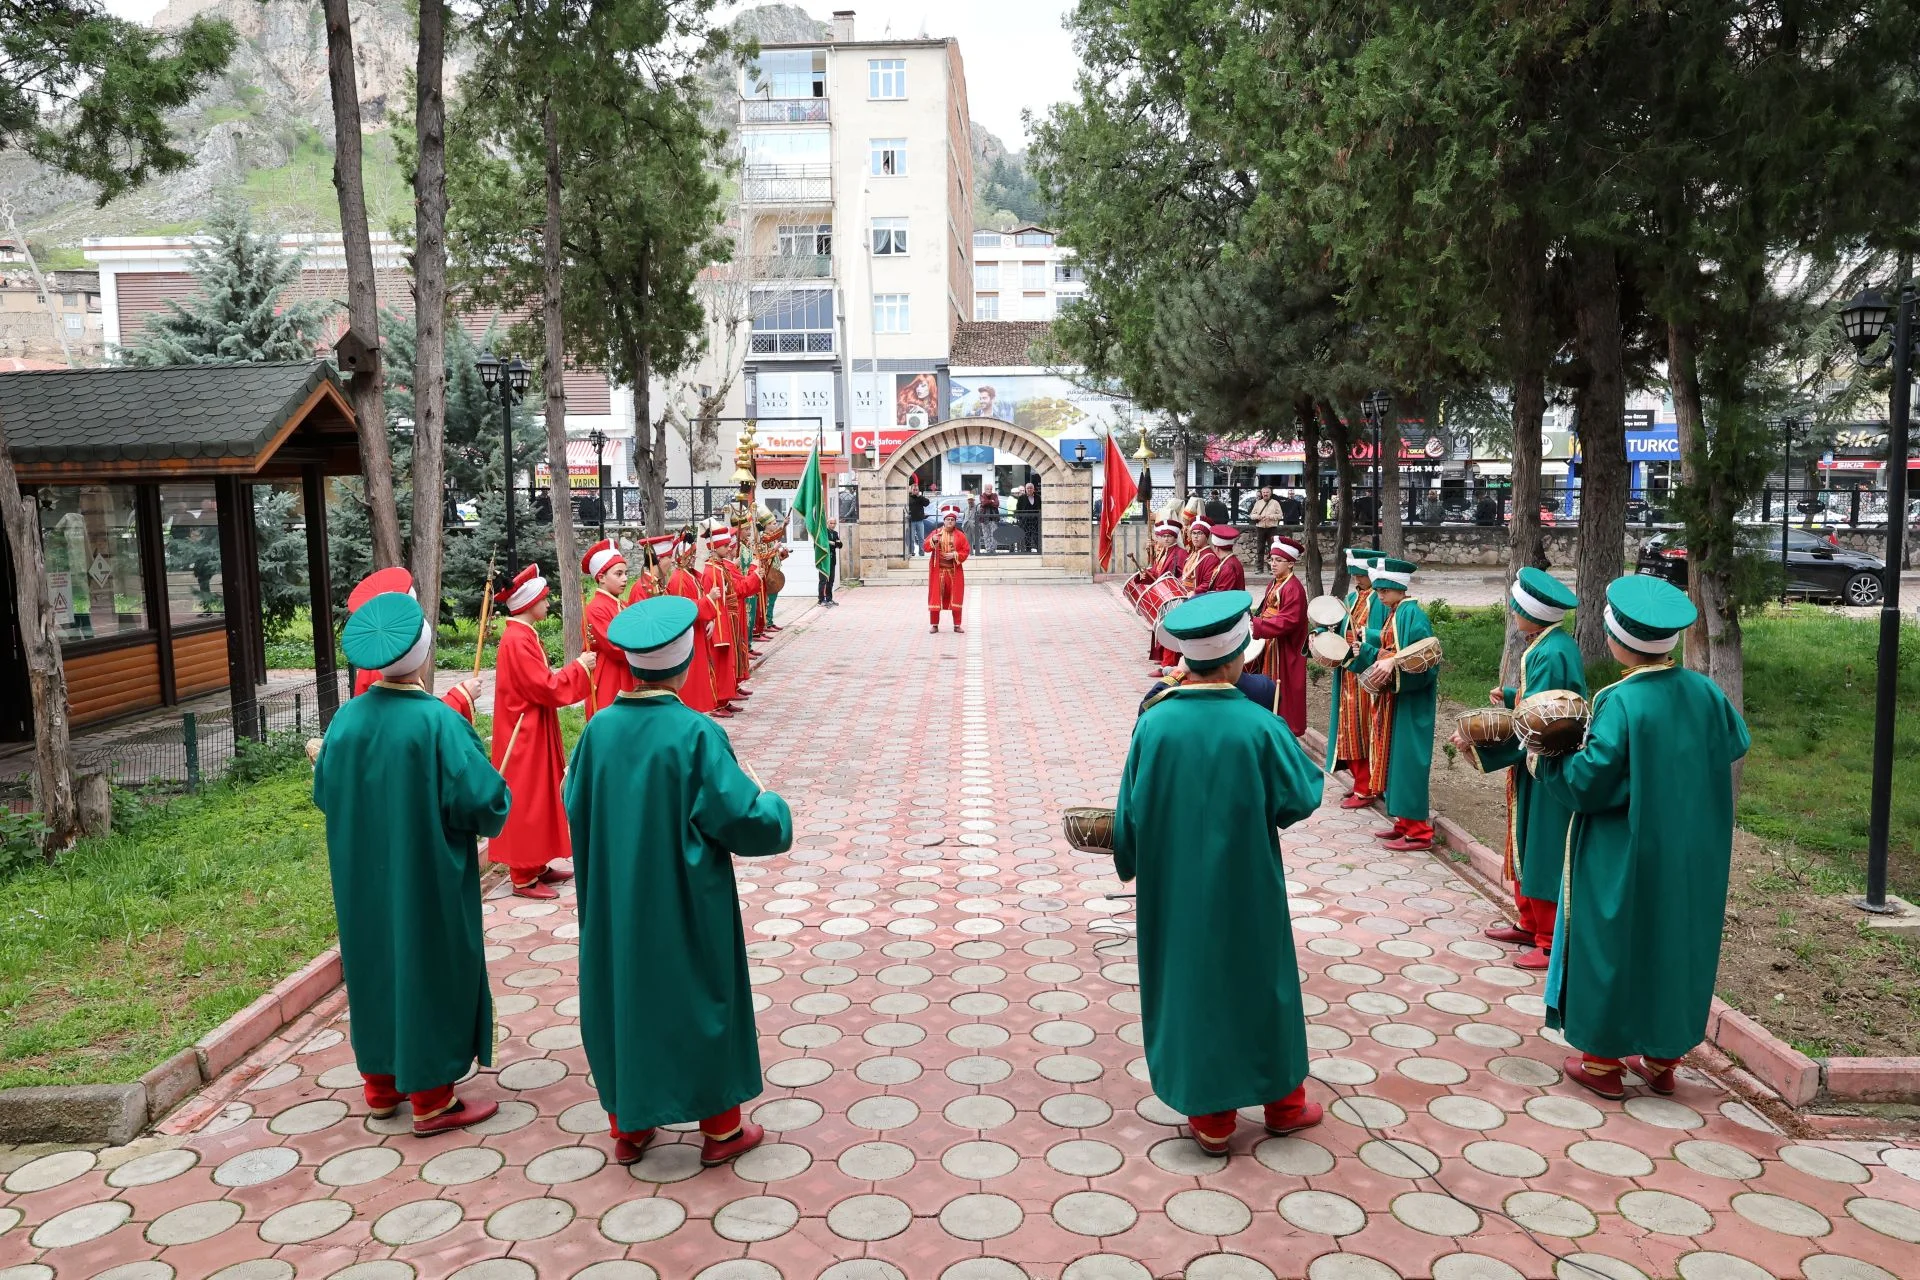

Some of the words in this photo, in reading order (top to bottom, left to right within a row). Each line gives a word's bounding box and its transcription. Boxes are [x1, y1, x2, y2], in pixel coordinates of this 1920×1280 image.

[762, 391, 788, 408] MS
[802, 390, 829, 407] MS
[767, 436, 827, 447] TeknoCll
[1627, 438, 1680, 453] TURKC
[1367, 465, 1384, 473] AO
